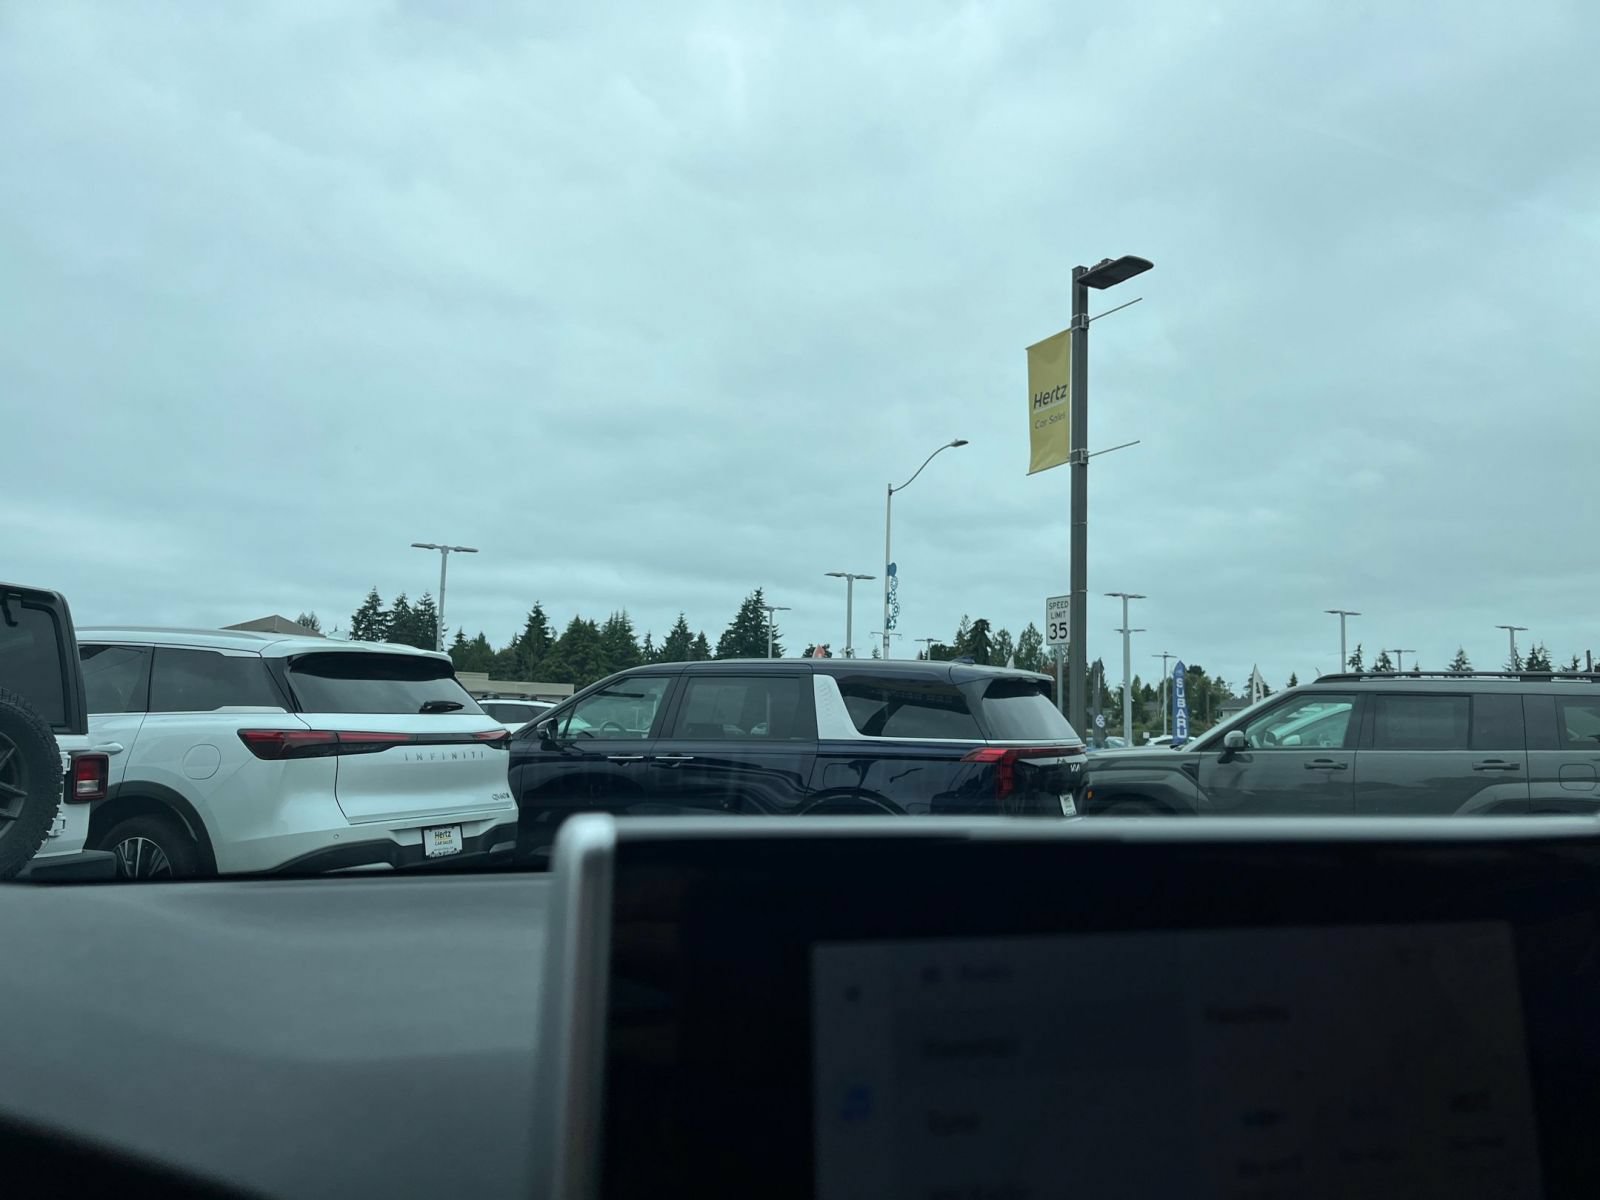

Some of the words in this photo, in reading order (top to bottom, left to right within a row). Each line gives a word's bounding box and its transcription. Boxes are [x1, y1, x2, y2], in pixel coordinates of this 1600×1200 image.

[1033, 384, 1067, 409] Hertz
[1049, 600, 1069, 610] SPEED
[1050, 610, 1066, 620] LIMIT
[1049, 622, 1068, 640] 35
[1176, 677, 1187, 739] SUBARU
[404, 751, 484, 761] INFINITI
[434, 830, 452, 839] Hertz
